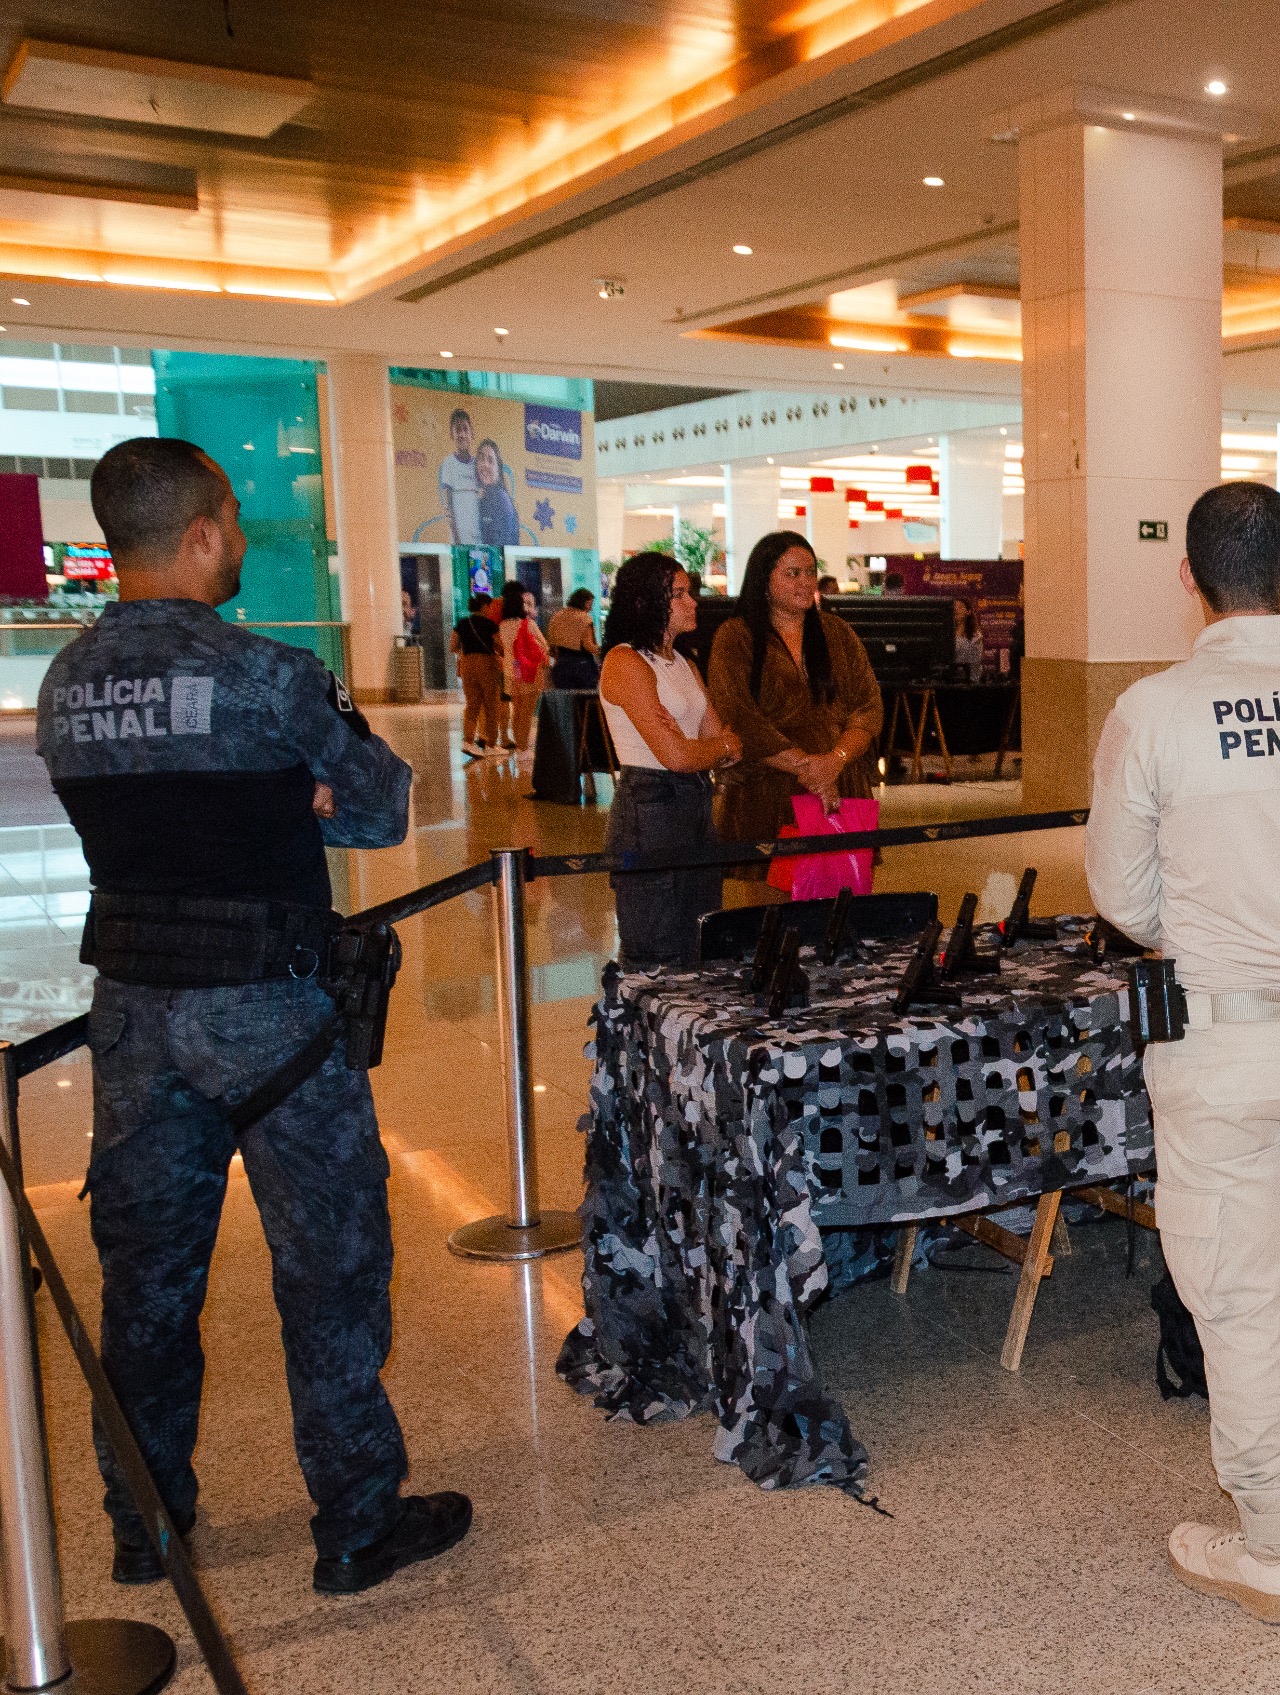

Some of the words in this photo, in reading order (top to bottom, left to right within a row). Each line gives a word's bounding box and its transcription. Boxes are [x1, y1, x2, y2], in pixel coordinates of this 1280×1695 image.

[541, 423, 581, 445] Darwin
[53, 674, 166, 711] POLÍCIA
[53, 708, 167, 742] PENAL
